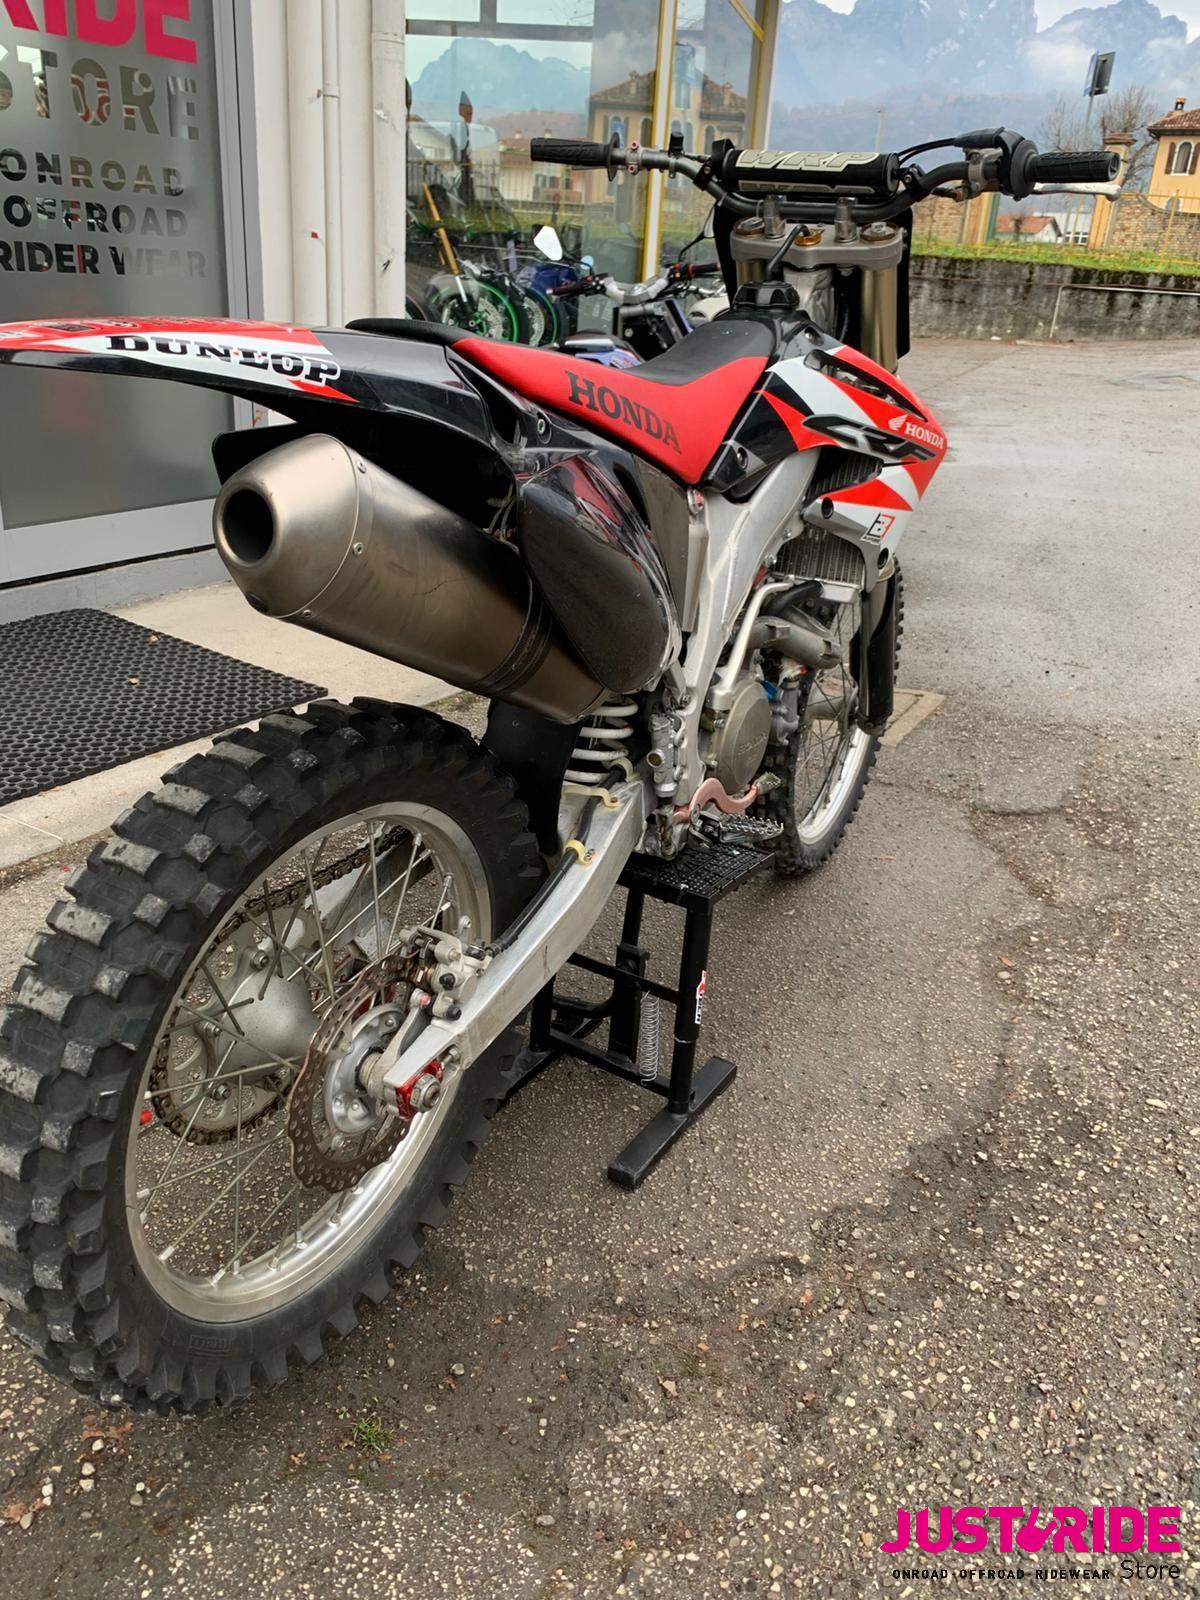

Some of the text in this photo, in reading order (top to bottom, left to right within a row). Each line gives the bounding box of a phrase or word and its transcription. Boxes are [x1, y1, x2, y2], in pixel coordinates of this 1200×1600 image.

[0, 148, 184, 197] ONROAD
[736, 150, 880, 172] WRP
[3, 194, 188, 237] OFFROAD
[108, 246, 206, 279] WEAR
[105, 334, 340, 385] DUNLOP
[565, 370, 682, 455] HONDA
[904, 422, 944, 449] HONDA
